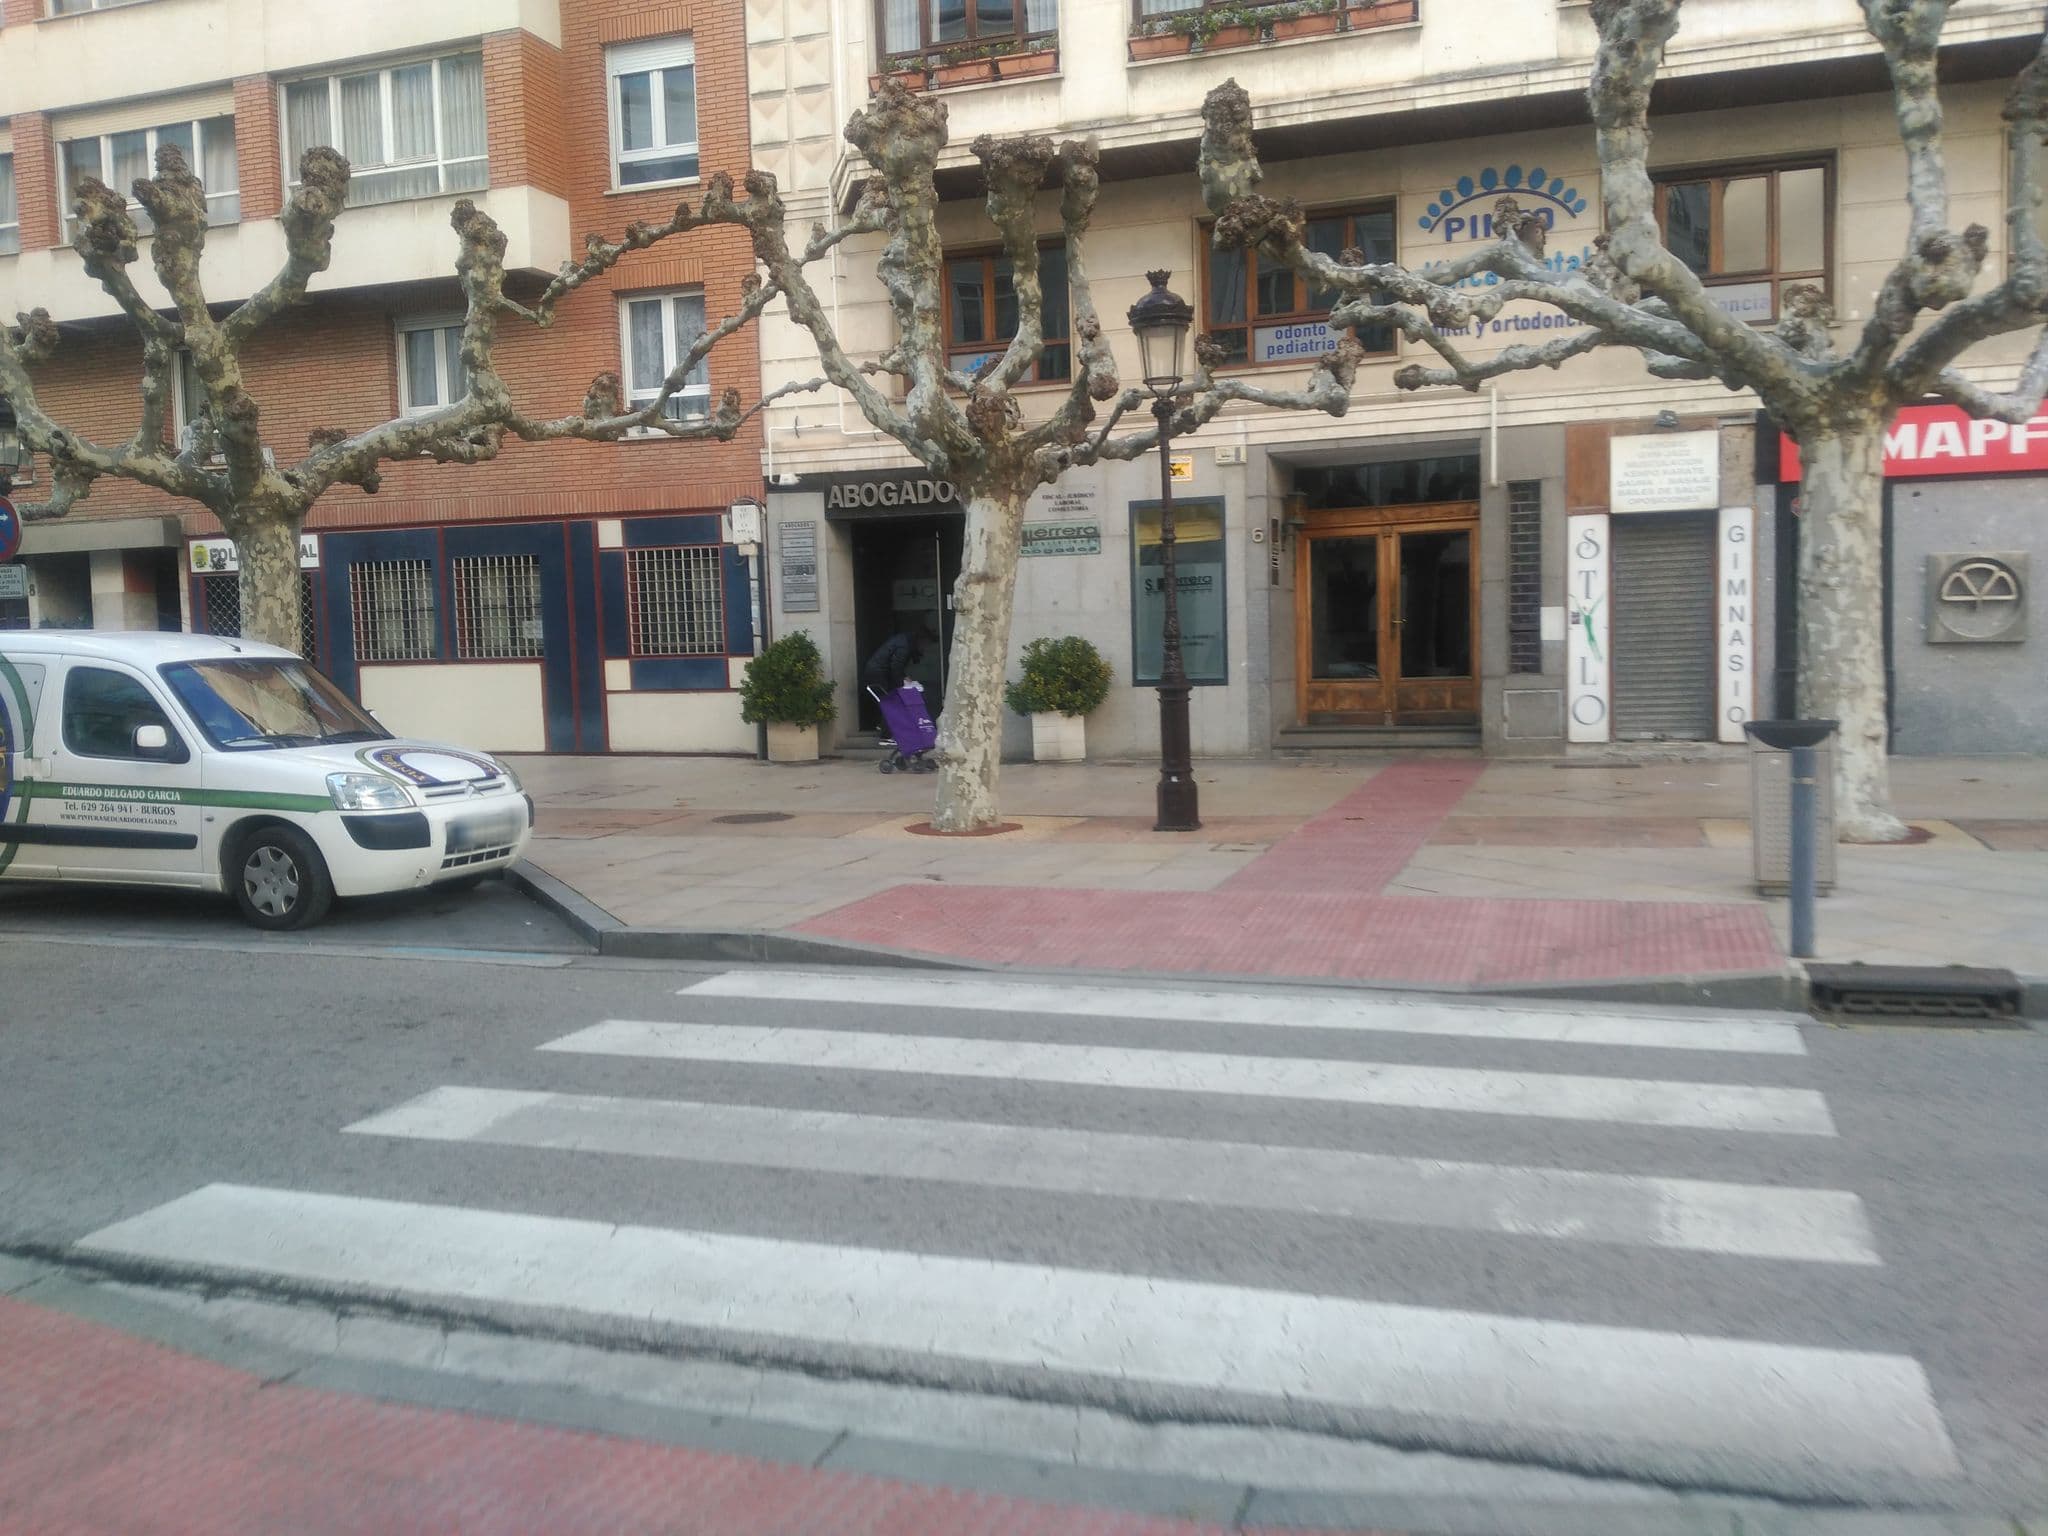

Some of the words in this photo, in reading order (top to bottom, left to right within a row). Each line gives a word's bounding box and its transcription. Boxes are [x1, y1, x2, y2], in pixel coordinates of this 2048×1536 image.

[1275, 323, 1327, 340] odonto
[1266, 337, 1336, 359] pediatría
[1882, 416, 2048, 460] MAPF
[1252, 528, 1264, 543] 6
[29, 583, 36, 597] 8
[1727, 525, 1747, 724] GIMNASIO
[62, 786, 103, 798] EDUARDO
[104, 788, 146, 799] DELGADO
[147, 790, 181, 801] GARCIA
[64, 801, 78, 811] Tel.
[81, 802, 97, 811] 629
[99, 803, 115, 813] 264
[117, 804, 133, 814] 941
[141, 805, 176, 816] BURGOS
